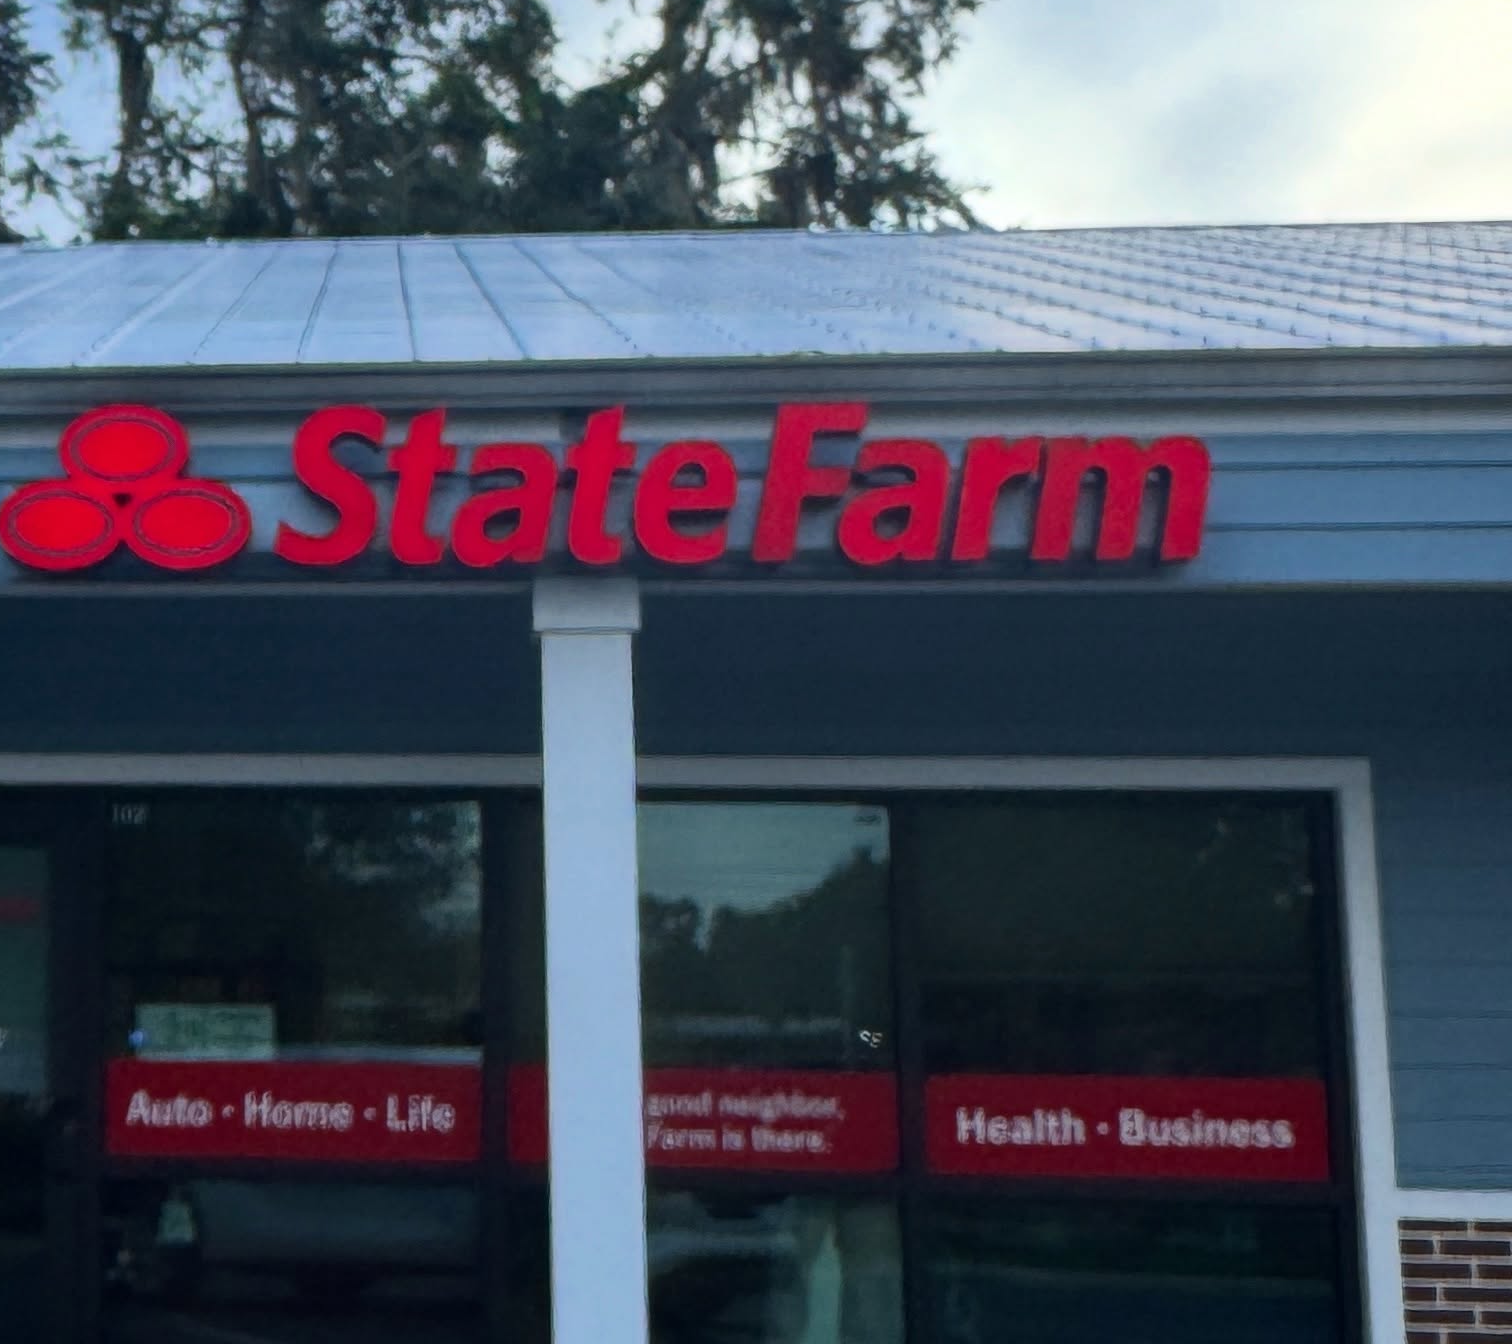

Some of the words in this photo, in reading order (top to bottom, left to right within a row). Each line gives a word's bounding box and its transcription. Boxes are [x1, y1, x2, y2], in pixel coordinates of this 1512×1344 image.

[126, 1089, 213, 1127] Auto
[243, 1090, 355, 1131] Home
[386, 1092, 457, 1133] Life
[955, 1106, 1087, 1146] Health
[1118, 1107, 1296, 1149] Business
